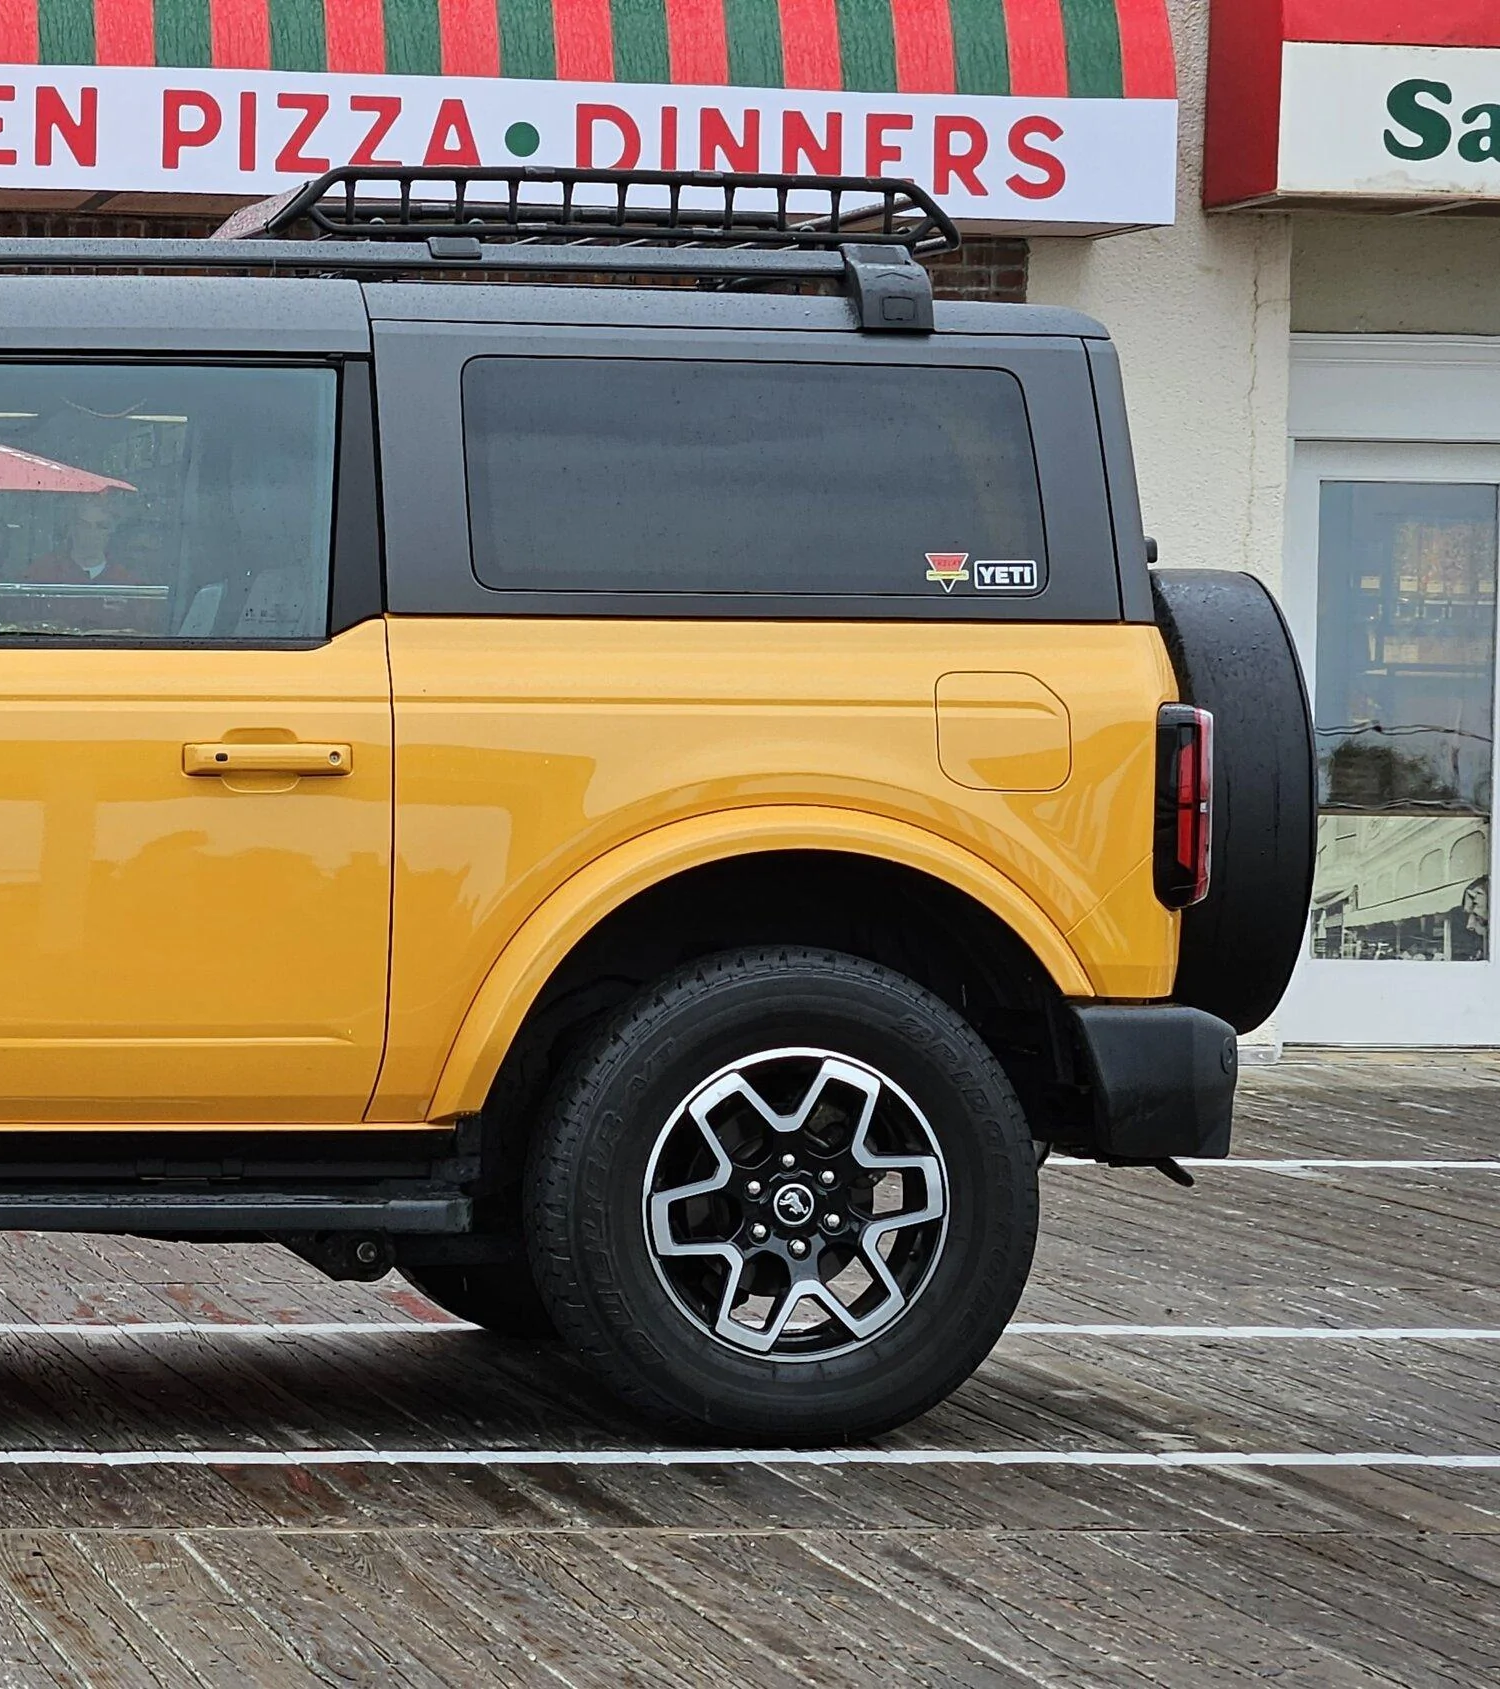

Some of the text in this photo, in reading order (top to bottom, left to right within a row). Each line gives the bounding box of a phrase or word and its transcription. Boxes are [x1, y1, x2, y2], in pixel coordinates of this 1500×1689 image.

[162, 90, 481, 173] PIZZA
[575, 103, 1066, 199] DINNERS
[1383, 78, 1500, 163] Sa
[979, 566, 1032, 584] YETI
